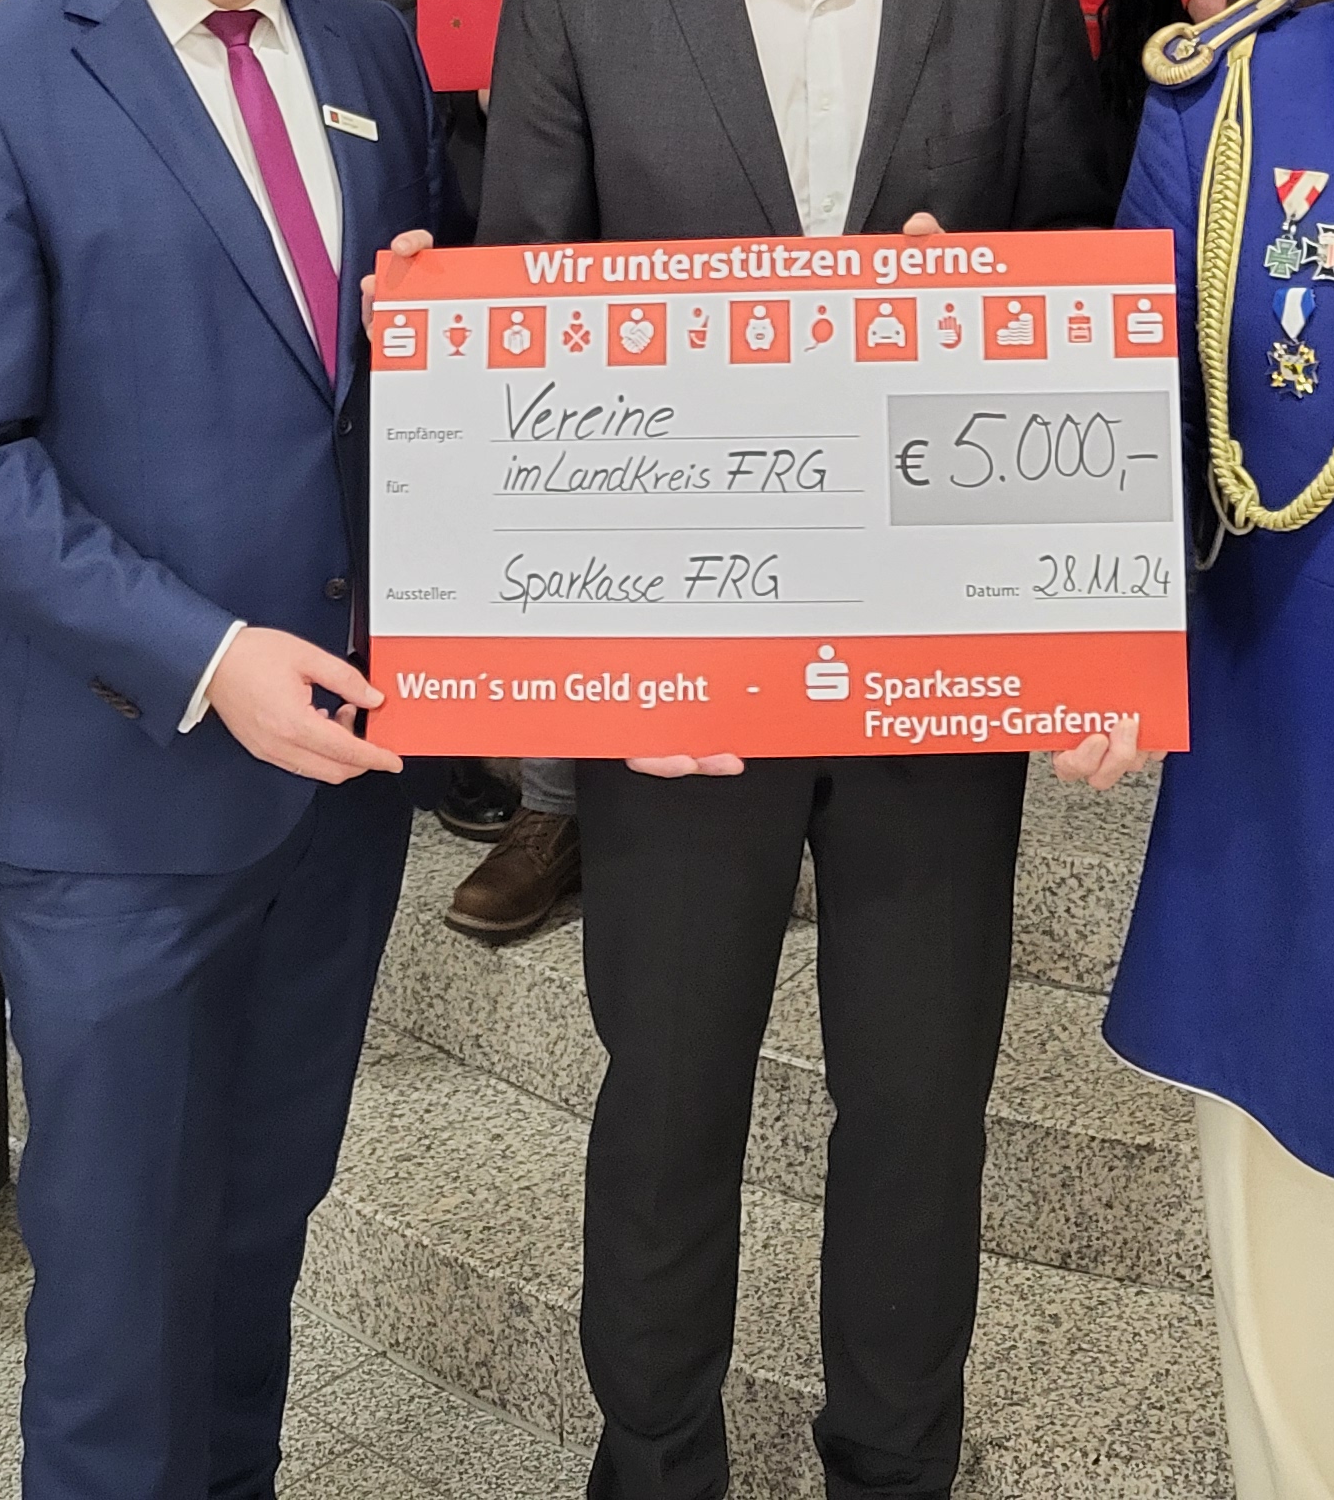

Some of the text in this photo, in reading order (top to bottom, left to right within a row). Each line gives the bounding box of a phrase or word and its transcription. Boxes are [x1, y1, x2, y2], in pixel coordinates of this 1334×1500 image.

[524, 243, 1008, 285] Wir unterstützen gerne.
[505, 381, 675, 440] Vereine
[727, 449, 827, 493] FRG
[386, 586, 457, 601] Aussteller:
[683, 553, 779, 600] FRG
[965, 584, 1020, 598] Datum:
[1033, 553, 1171, 597] 28.11.24
[511, 678, 557, 701] um
[564, 671, 631, 701] Geld
[637, 673, 710, 709] geht
[864, 669, 1022, 706] Sparkasse
